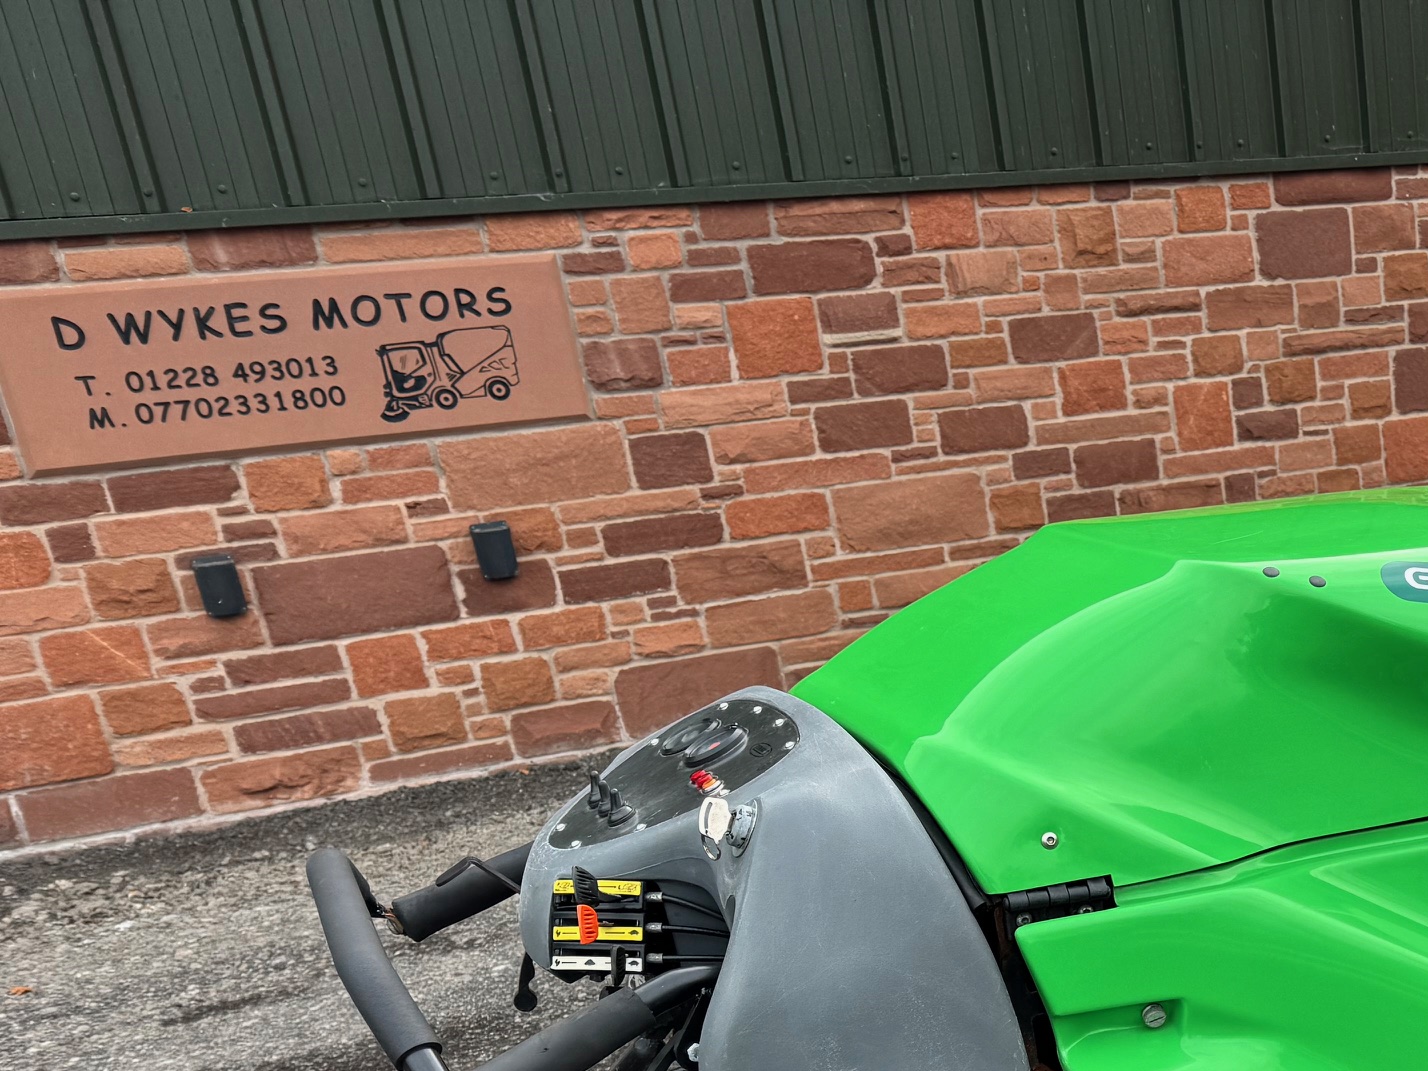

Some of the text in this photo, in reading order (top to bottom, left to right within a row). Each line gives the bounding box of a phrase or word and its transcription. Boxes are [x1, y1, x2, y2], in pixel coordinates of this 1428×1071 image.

[51, 286, 512, 351] D WYKES MOTORS
[125, 365, 220, 394] 01228
[232, 355, 339, 384] 493013
